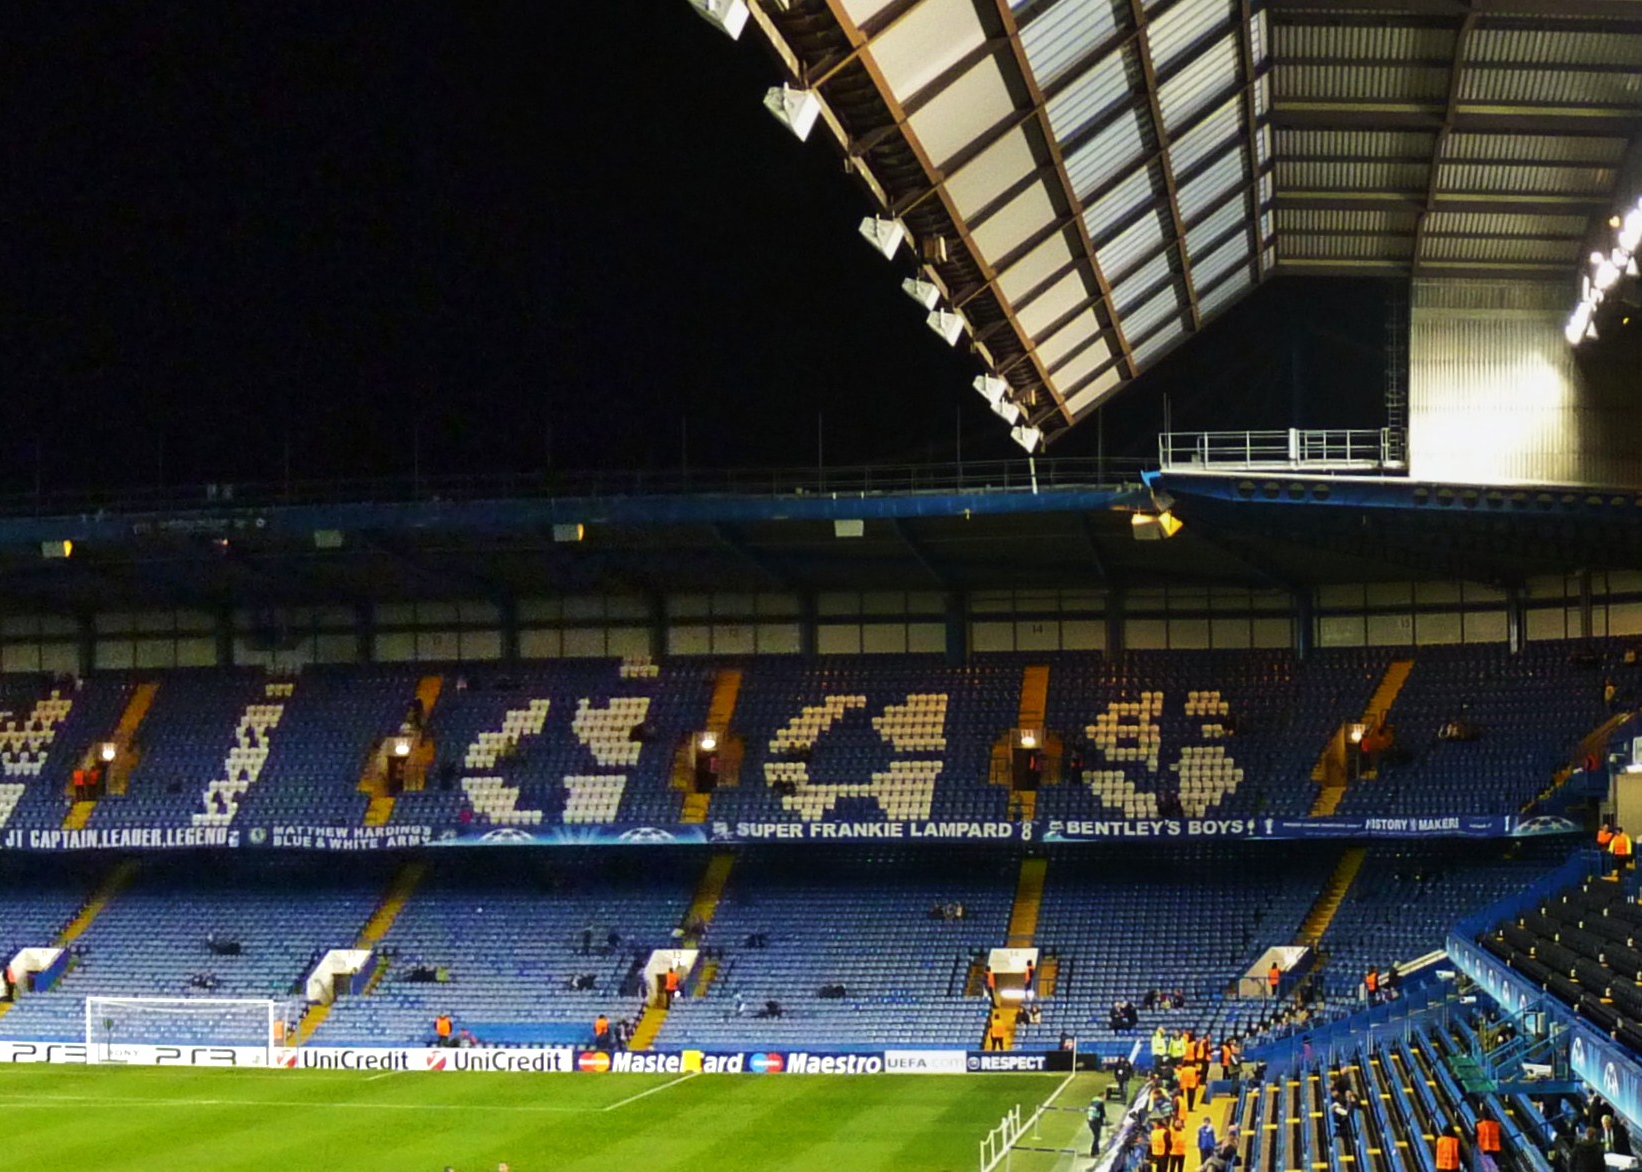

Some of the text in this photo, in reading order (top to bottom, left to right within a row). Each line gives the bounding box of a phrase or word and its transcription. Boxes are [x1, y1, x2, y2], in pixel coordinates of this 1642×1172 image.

[273, 825, 348, 837] MATTHEW
[736, 822, 803, 838] SUPER
[810, 822, 903, 838] FRANKIE
[910, 821, 1012, 838] LAMPARD
[1066, 819, 1244, 836] BENTLEY'S BOYS
[273, 836, 312, 847] BLUE
[329, 838, 378, 850] WHITE
[386, 835, 432, 847] ARMY
[303, 1050, 409, 1070] UniCredit
[454, 1051, 562, 1072] UniCredit
[786, 1053, 882, 1074] Maestro
[980, 1056, 1046, 1070] RESPECT
